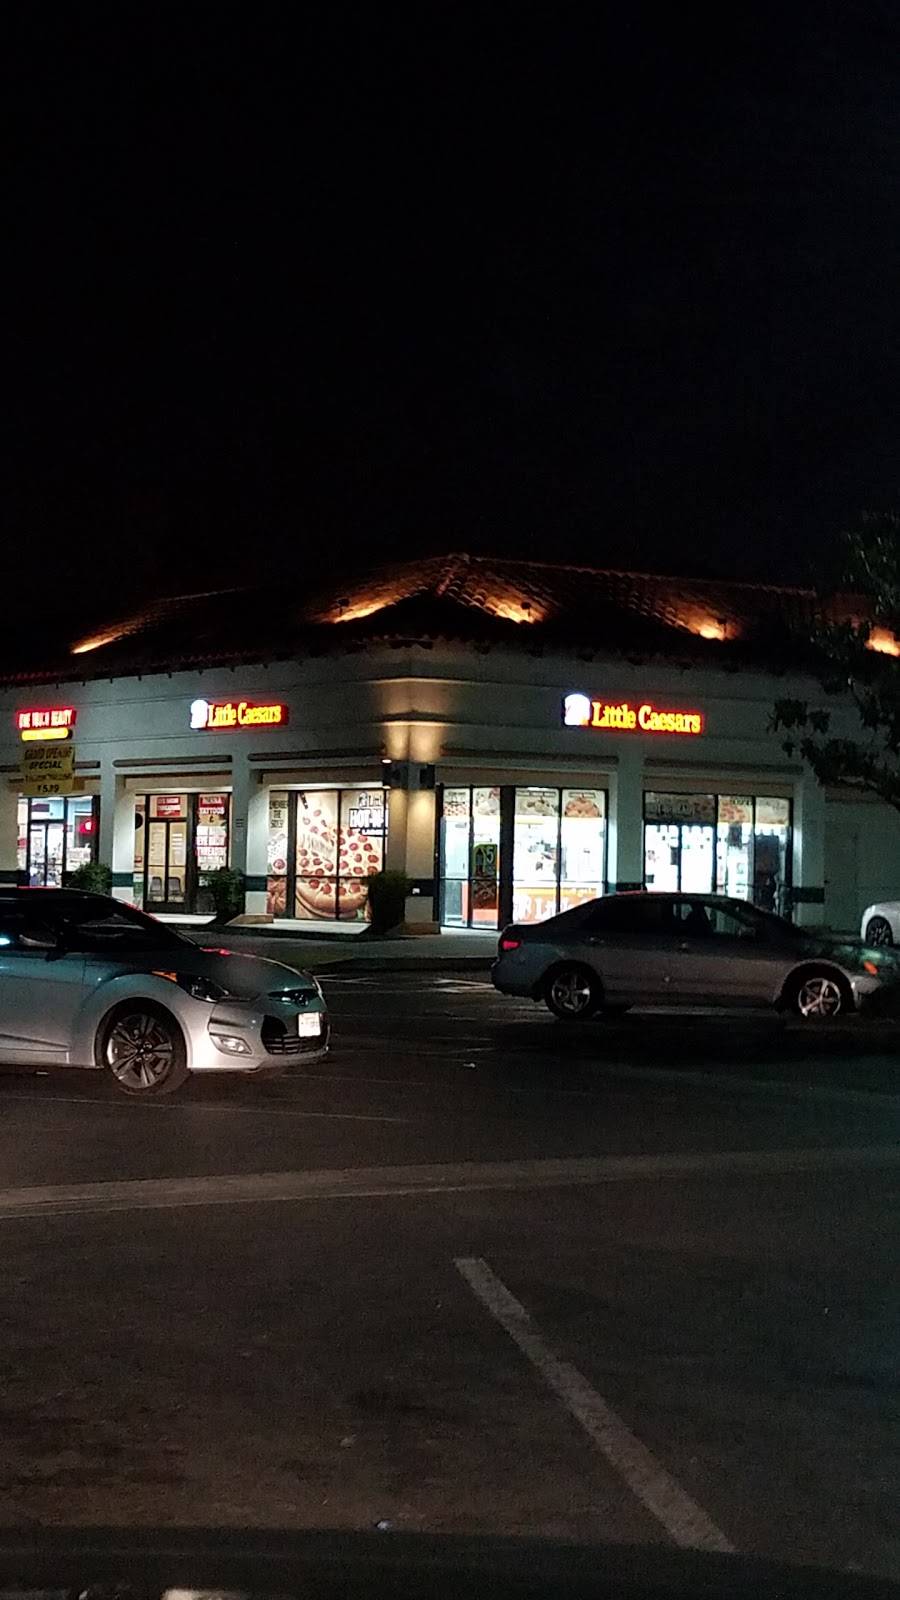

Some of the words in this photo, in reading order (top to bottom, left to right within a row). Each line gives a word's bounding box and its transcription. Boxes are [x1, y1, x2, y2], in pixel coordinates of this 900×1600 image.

[207, 703, 236, 727] Little
[238, 702, 281, 724] Caesars
[591, 702, 636, 729] Little
[638, 704, 701, 734] Caesars
